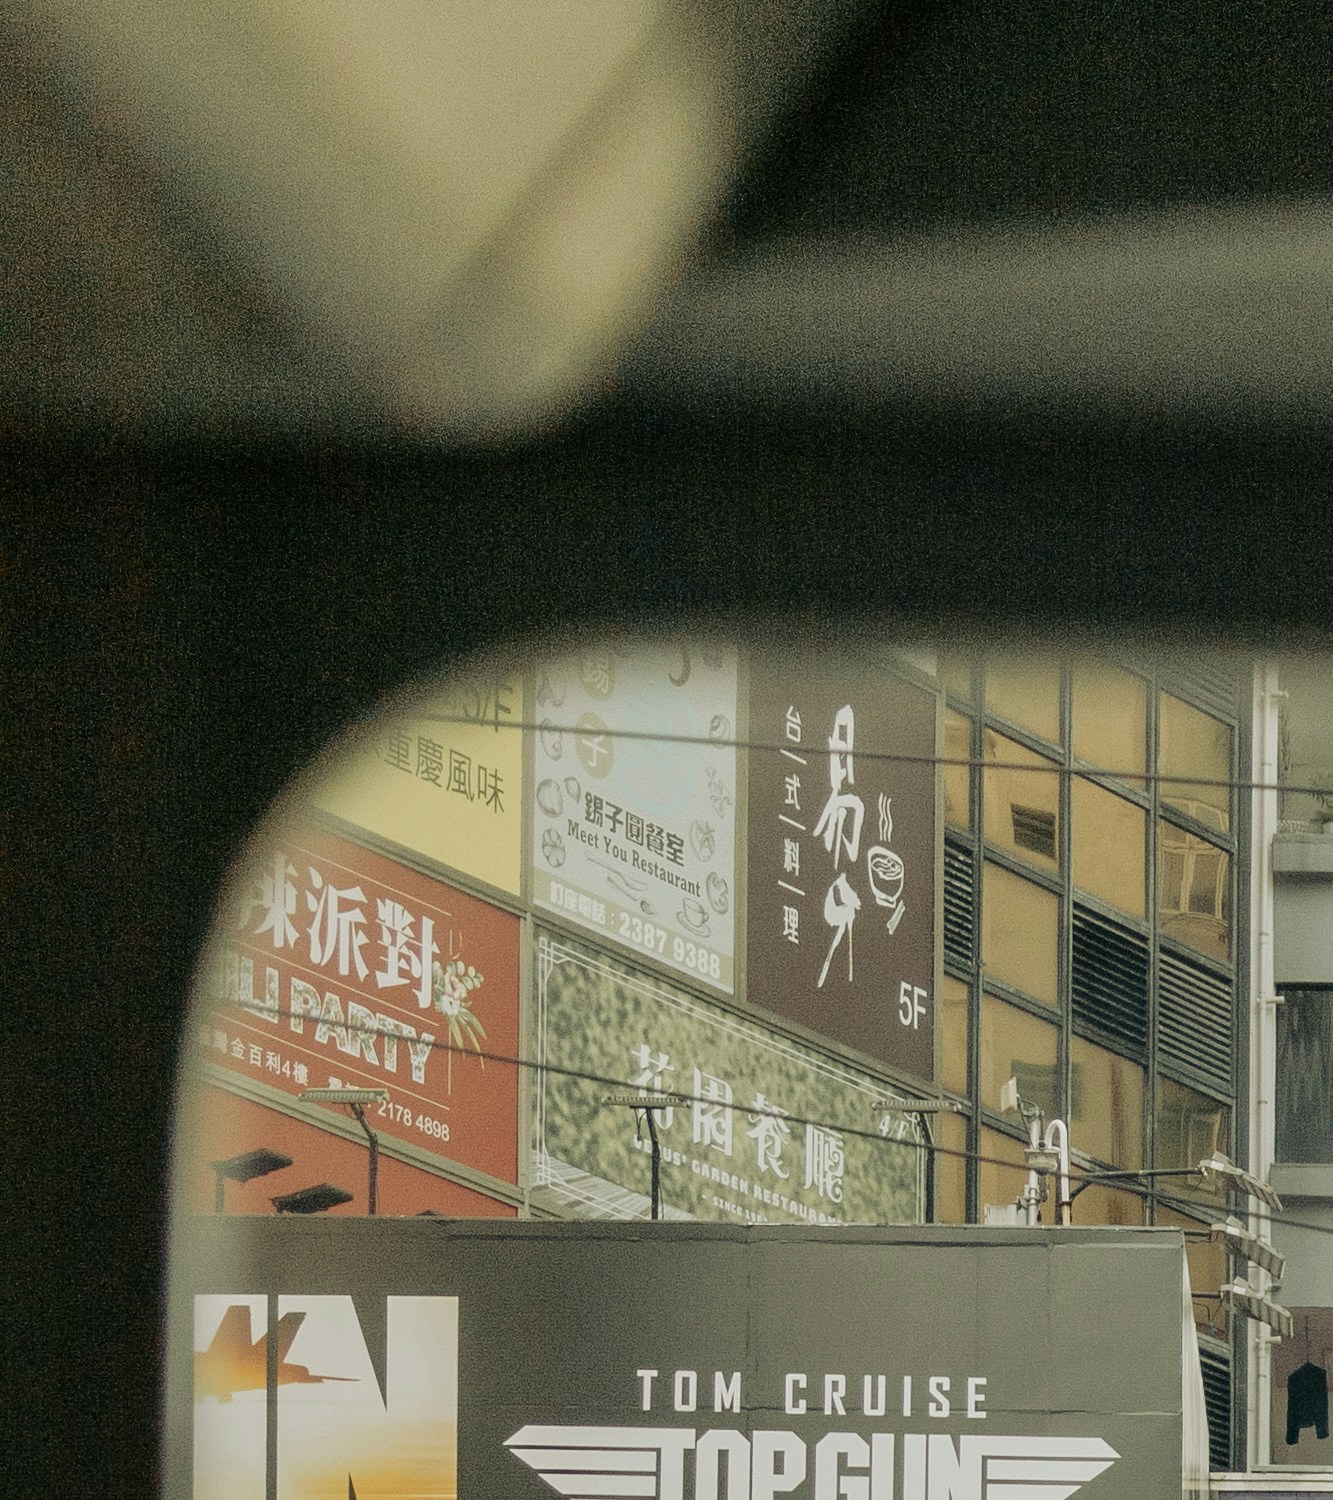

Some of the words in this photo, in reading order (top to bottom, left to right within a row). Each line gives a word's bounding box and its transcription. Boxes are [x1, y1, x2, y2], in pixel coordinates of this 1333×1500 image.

[567, 818, 600, 850] Meet
[602, 834, 628, 862] You
[632, 848, 701, 898] Restaurant
[619, 911, 665, 953] 2387
[673, 938, 721, 980] 9388
[290, 975, 436, 1085] PARTY
[899, 980, 928, 1031] 5F
[378, 1098, 412, 1128] 2178
[415, 1112, 450, 1143] 4898
[691, 1159, 749, 1196] GARDEN
[636, 1368, 742, 1414] TOM
[785, 1373, 988, 1420] CRUISE
